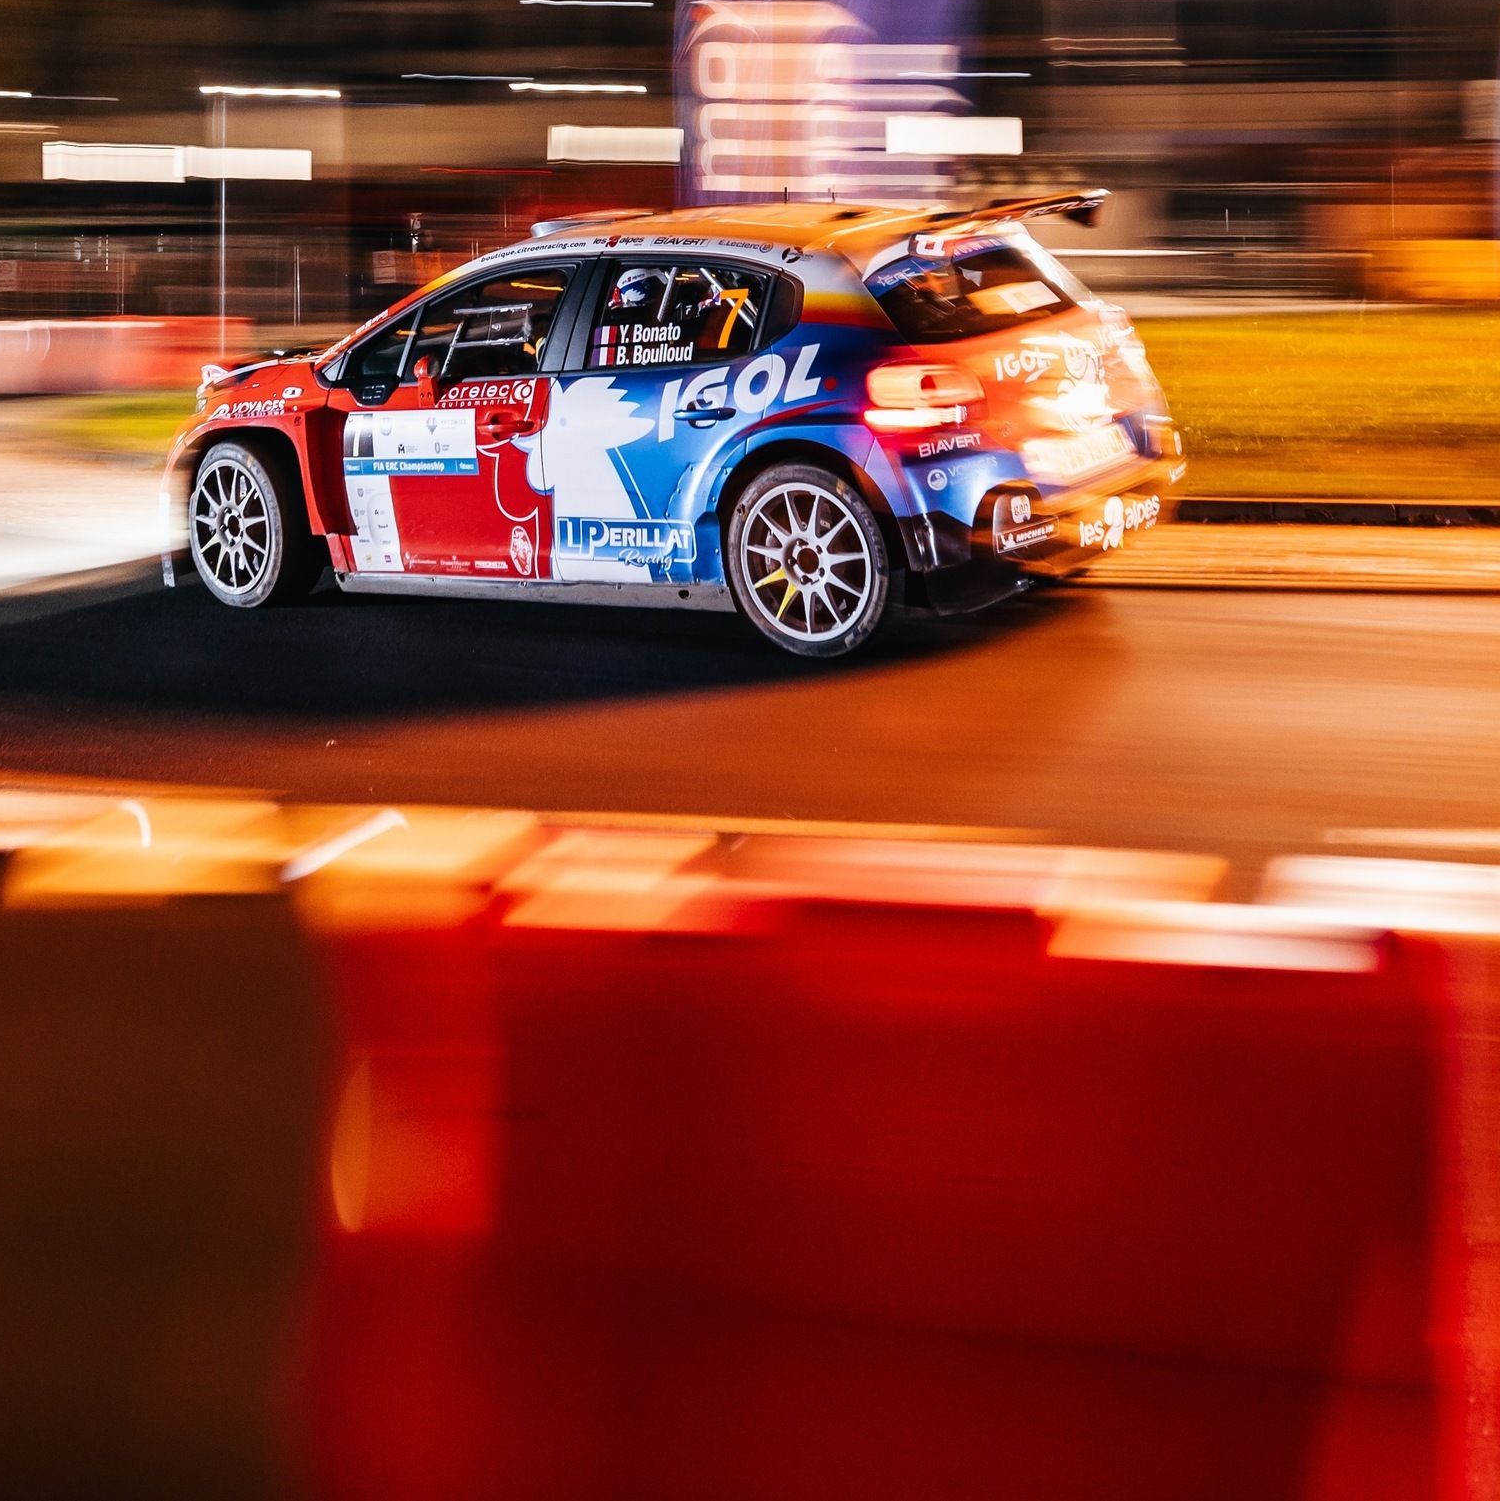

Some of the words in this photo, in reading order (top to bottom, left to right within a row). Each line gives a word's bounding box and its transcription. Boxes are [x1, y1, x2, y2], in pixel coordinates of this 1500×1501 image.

[481, 241, 586, 263] boutique.citroenracing.com
[619, 236, 644, 246] alpes
[718, 288, 749, 348] 7
[619, 324, 629, 344] Y.
[632, 322, 681, 344] Bonato
[616, 345, 630, 365] B.
[632, 341, 694, 365] Boulloud
[440, 382, 510, 400] orelec
[231, 399, 286, 414] VOYAGES
[918, 433, 981, 458] BIAVERT
[373, 462, 384, 471] FIA
[385, 462, 398, 471] ERC
[399, 461, 445, 473] Championship
[1013, 503, 1029, 516] gan
[1016, 524, 1055, 542] MICHELIN
[1079, 519, 1105, 548] les
[1102, 496, 1125, 551] 2
[1125, 495, 1161, 531] alpes
[618, 548, 674, 571] Racing
